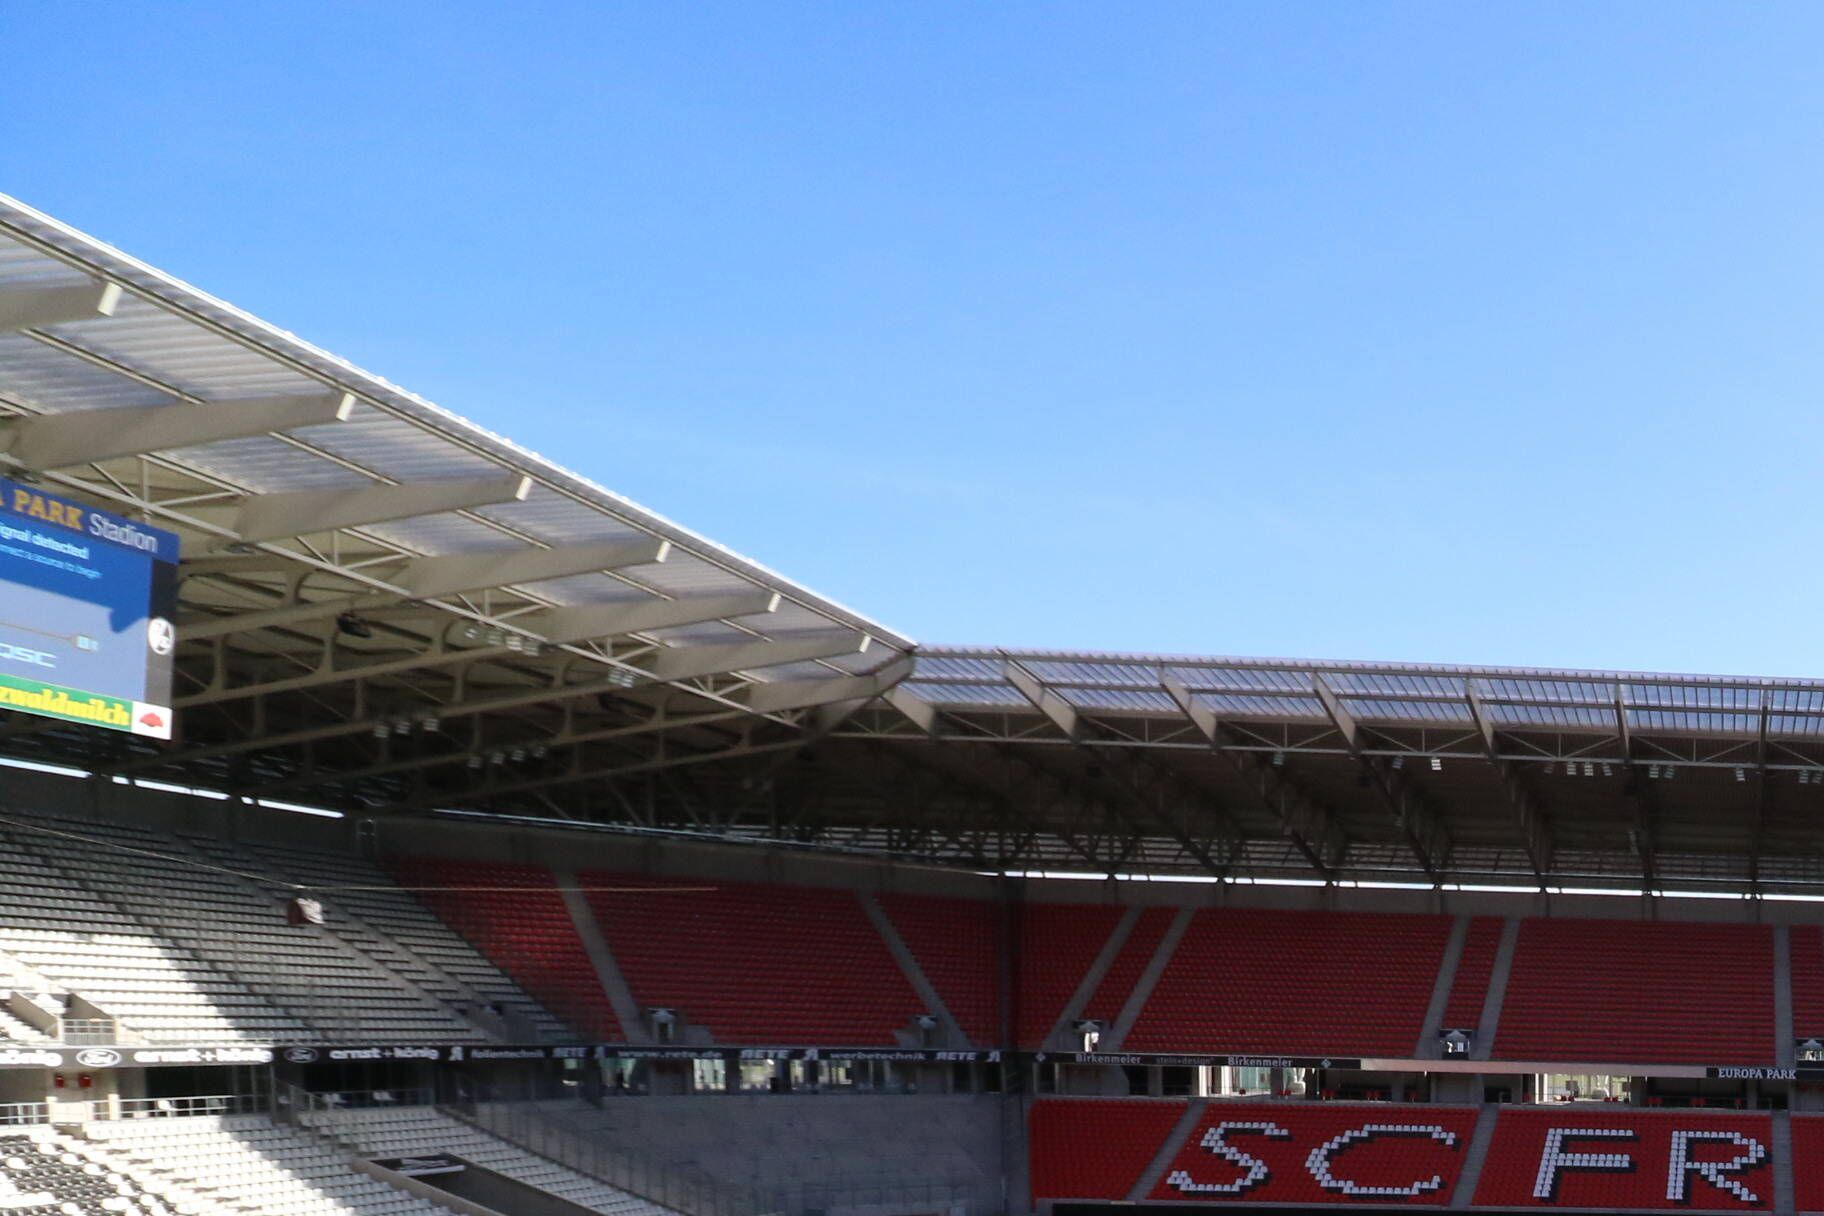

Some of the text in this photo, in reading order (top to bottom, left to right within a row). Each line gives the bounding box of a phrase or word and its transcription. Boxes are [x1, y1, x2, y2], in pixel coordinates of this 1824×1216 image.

[13, 488, 159, 553] PARK Stadion
[830, 1051, 977, 1061] werbetechnik RETE
[1075, 1054, 1142, 1064] Birkenmeier
[1227, 1056, 1293, 1067] Birkenmeier
[1718, 1068, 1797, 1080] EUROPA PARK
[1167, 1121, 1457, 1196] SC
